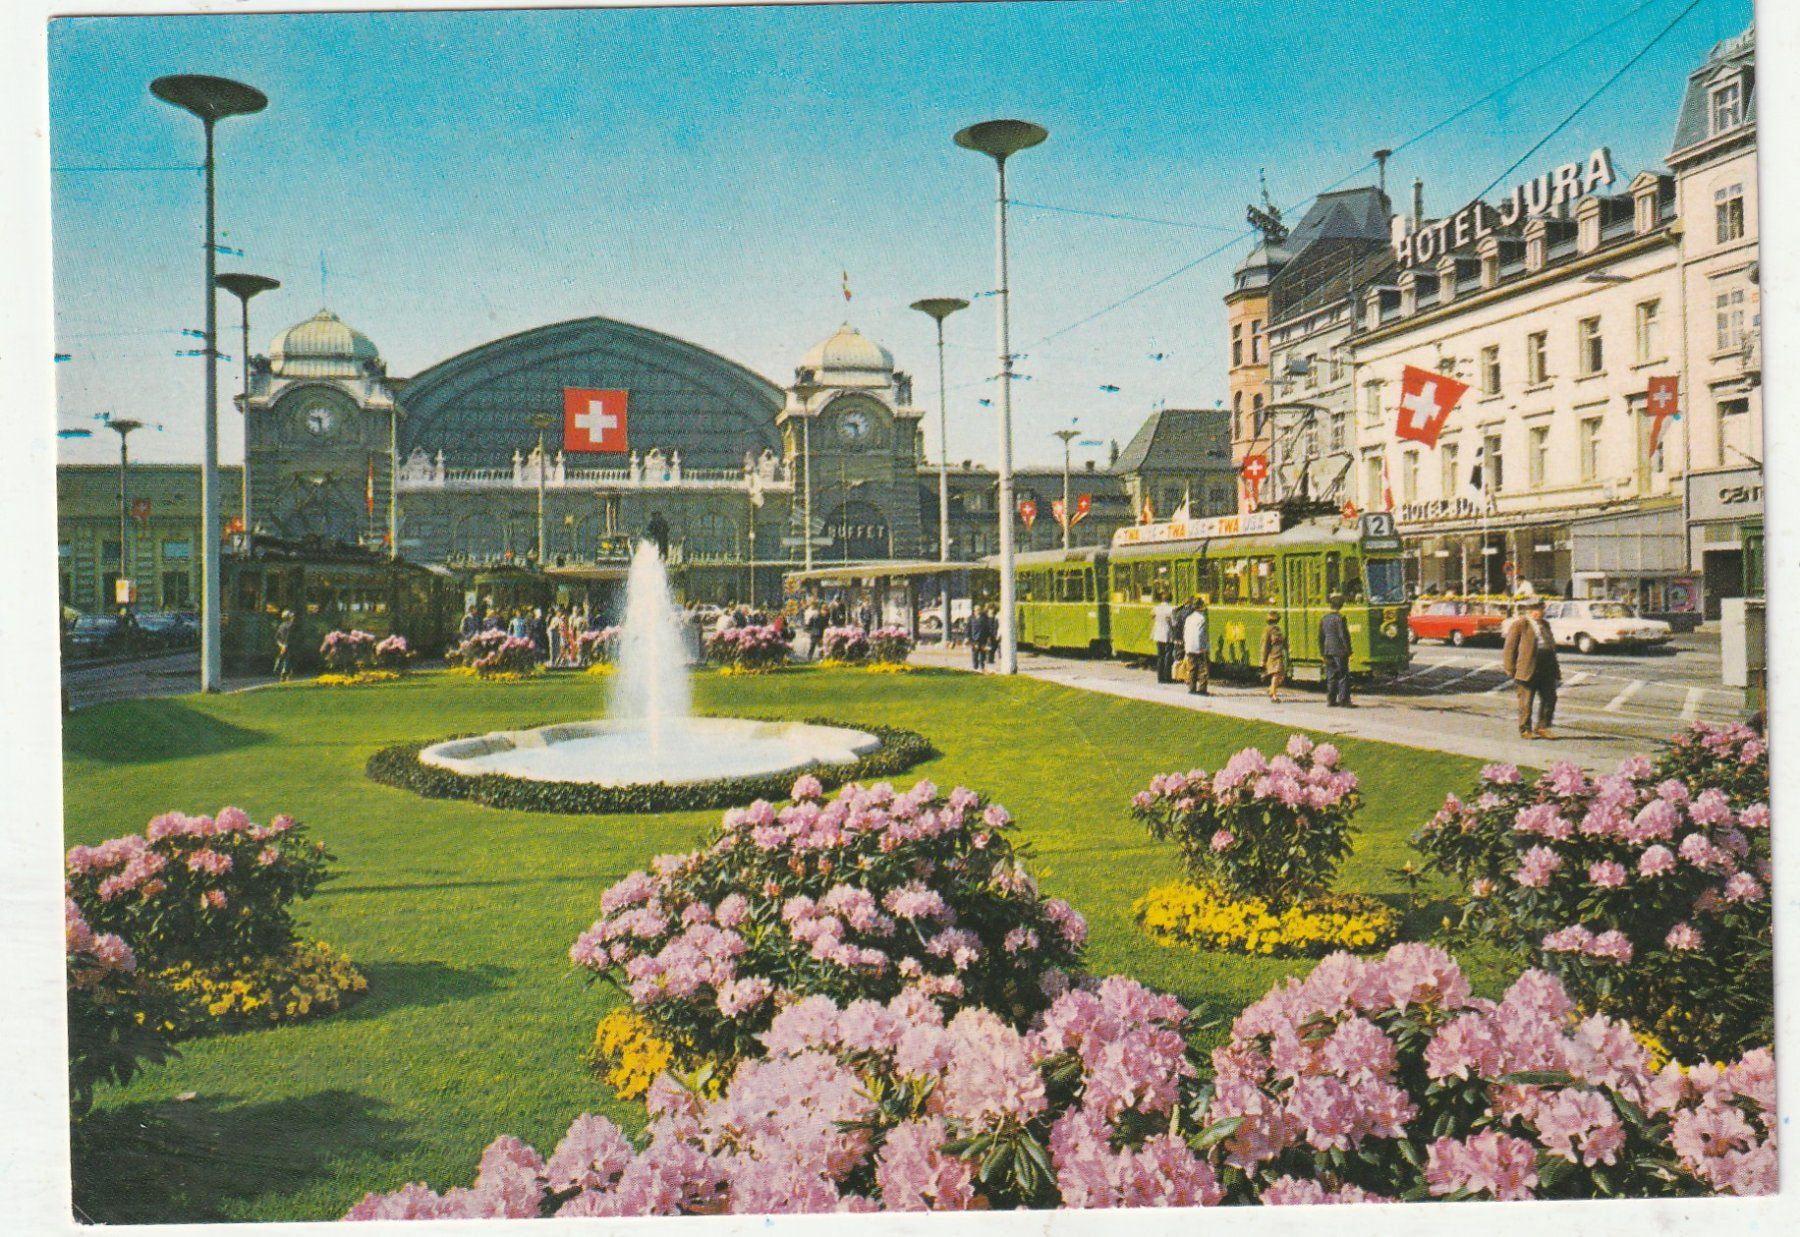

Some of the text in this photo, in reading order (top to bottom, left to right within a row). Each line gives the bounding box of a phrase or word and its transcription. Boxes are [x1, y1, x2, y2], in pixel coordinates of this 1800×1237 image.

[1396, 146, 1616, 268] HOTEL JURA
[827, 524, 885, 539] BUFFET
[1167, 523, 1186, 538] TWA
[1217, 517, 1240, 534] TWA
[1371, 515, 1385, 535] 2
